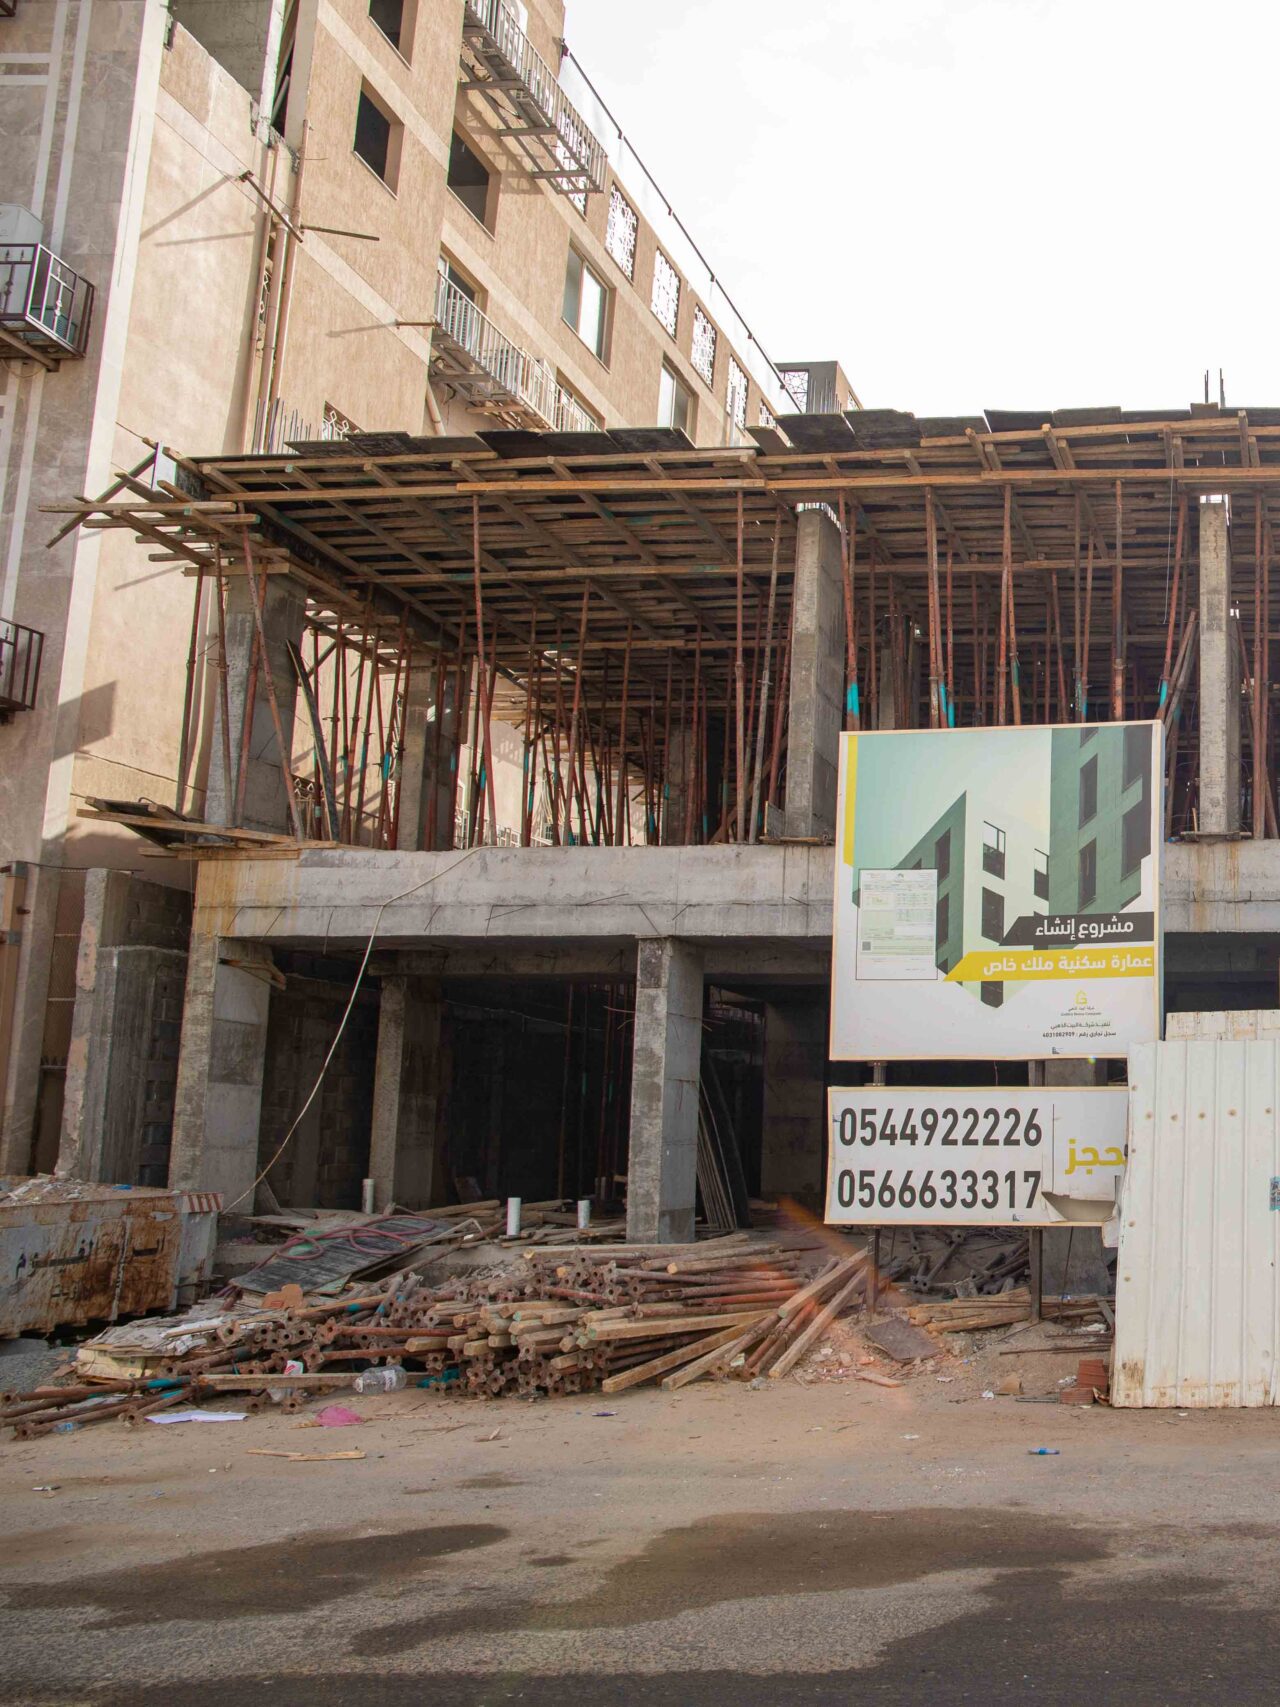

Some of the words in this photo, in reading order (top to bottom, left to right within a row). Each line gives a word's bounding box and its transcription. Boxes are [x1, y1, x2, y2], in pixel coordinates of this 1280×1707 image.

[1035, 917, 1076, 941] إنشاء
[1078, 915, 1134, 939] مشروع
[983, 957, 1017, 976] خاص
[1021, 956, 1054, 971] ملك
[1058, 955, 1106, 974] سكنية
[1111, 954, 1153, 972] عمارة
[839, 1107, 1042, 1147] 0544922226
[837, 1169, 1042, 1209] 0566633317
